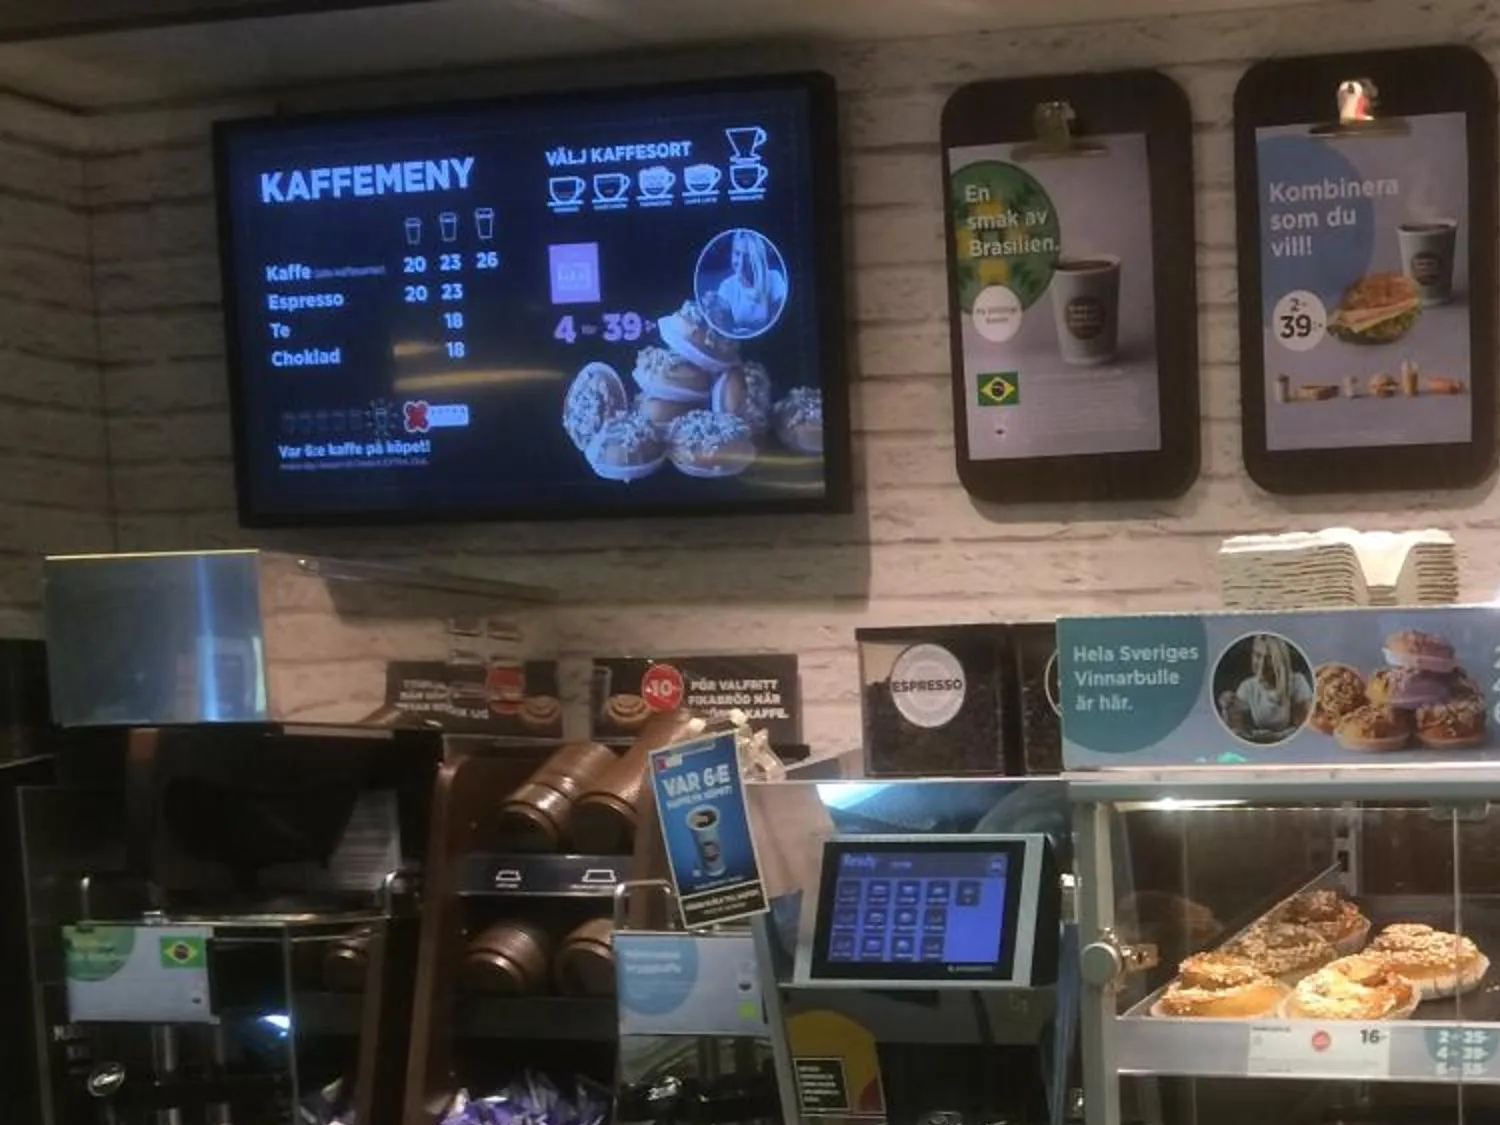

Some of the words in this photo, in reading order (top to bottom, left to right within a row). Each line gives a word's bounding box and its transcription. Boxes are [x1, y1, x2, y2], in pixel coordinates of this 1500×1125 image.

[545, 146, 587, 165] VÄLJ
[592, 140, 692, 163] KAFFESORT
[261, 157, 475, 203] KAFFEMENY
[1269, 177, 1399, 202] Kombinera
[965, 185, 990, 202] En
[967, 208, 1018, 229] smak
[1270, 211, 1319, 231] som
[1327, 206, 1357, 228] du
[970, 234, 1060, 257] Brasilien.
[1271, 235, 1313, 257] vill!
[266, 264, 312, 281] Kaffe
[403, 256, 427, 273] 20
[440, 254, 461, 271] 23
[476, 252, 499, 269] 26
[267, 293, 344, 312] Espresso
[404, 286, 428, 302] 20
[441, 283, 463, 300] 23
[269, 323, 291, 338] Te
[443, 312, 463, 329] 18
[554, 315, 576, 343] 4
[272, 348, 341, 366] Choklad
[445, 342, 466, 358] 18
[1073, 646, 1114, 662] Hela
[1119, 645, 1199, 665] Sveriges
[892, 680, 962, 693] ESPRESSO
[1075, 670, 1179, 688] Vinnarbulle
[1075, 695, 1094, 712] är
[1100, 694, 1133, 711] här.
[662, 771, 701, 798] VAR
